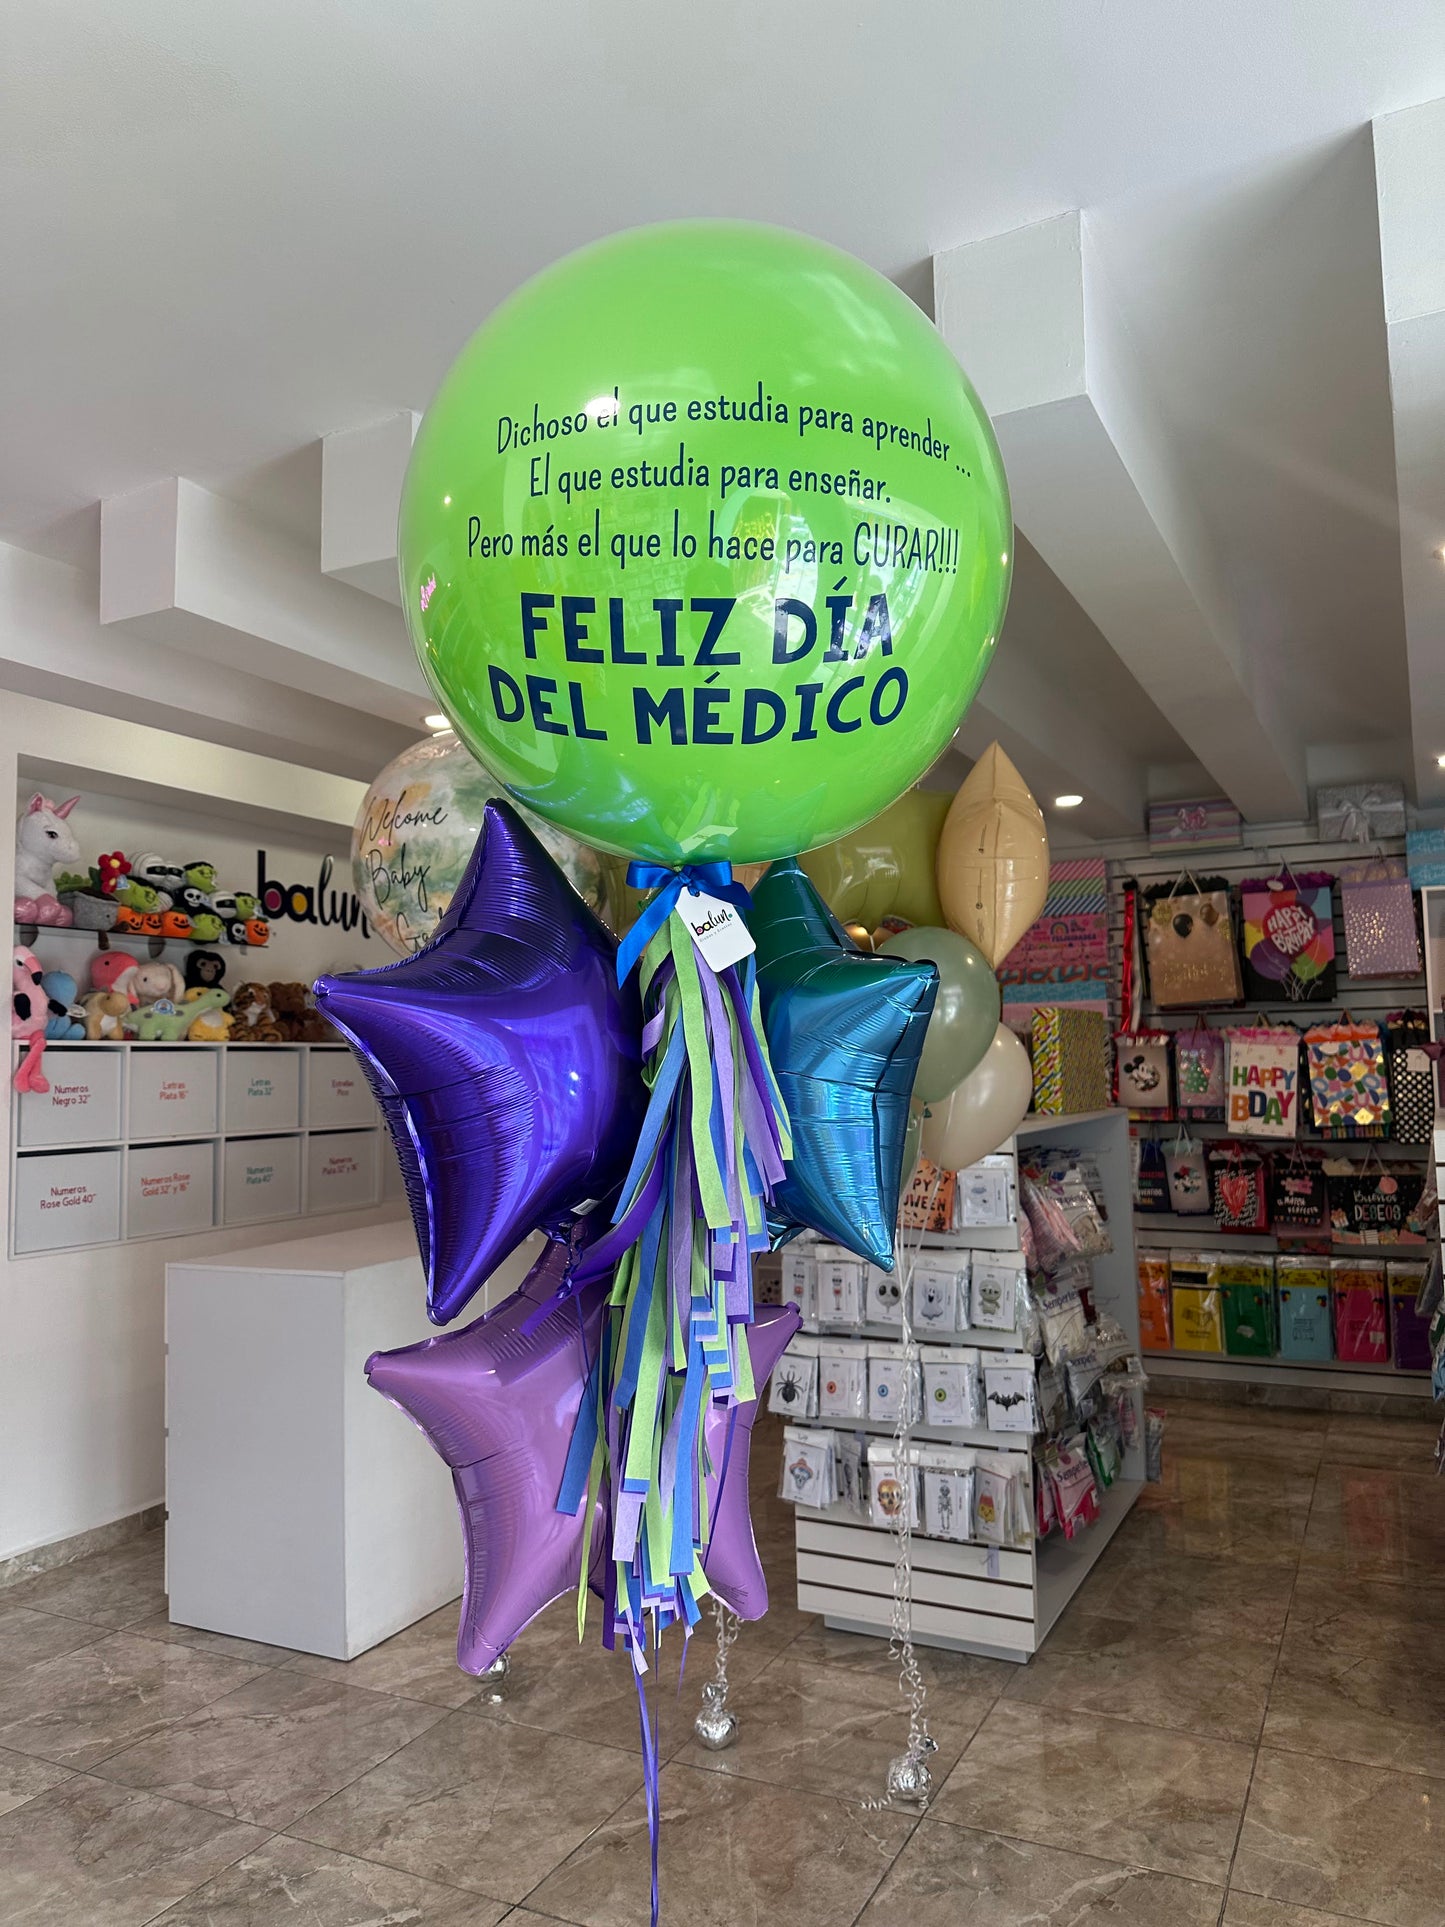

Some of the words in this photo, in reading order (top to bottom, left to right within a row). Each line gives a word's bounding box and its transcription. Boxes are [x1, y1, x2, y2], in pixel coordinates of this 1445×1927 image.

[497, 403, 588, 455] Dichoso
[597, 385, 619, 429] el
[628, 400, 677, 436] que
[687, 381, 789, 424] estudia
[799, 405, 853, 437] para
[861, 417, 950, 462] aprender
[530, 451, 550, 498] El
[558, 468, 602, 504] que
[610, 442, 710, 490] estudia
[721, 465, 779, 500] para
[788, 469, 892, 504] enseñar.
[468, 516, 514, 558] Pero
[521, 524, 569, 557] más
[577, 508, 600, 557] el
[610, 533, 662, 570] que
[672, 508, 698, 559] lo
[708, 509, 775, 561] hace
[785, 538, 844, 574] para
[854, 521, 960, 575] CURAR!!!
[520, 591, 741, 667] FELIZ
[772, 575, 893, 665] DÍA
[487, 664, 608, 741] DEL
[632, 666, 909, 746] MÉDICO
[360, 790, 449, 851] Welcome
[366, 843, 431, 913] Baby
[257, 849, 371, 939] balun
[1266, 905, 1309, 933] HAPPY
[54, 1085, 89, 1094] Numeros
[162, 1081, 186, 1090] Letras
[1232, 1065, 1296, 1091] HAPPY
[52, 1097, 77, 1108] Negro
[159, 1090, 178, 1100] Plata
[1231, 1090, 1295, 1126] BDAY
[50, 1185, 87, 1197] Numeros
[140, 1175, 172, 1187] Numeros
[173, 1172, 191, 1182] Rose
[142, 1186, 160, 1197] Gold
[40, 1199, 61, 1210] Rose
[62, 1196, 81, 1207] Gold
[1354, 1204, 1401, 1222] DESEOS
